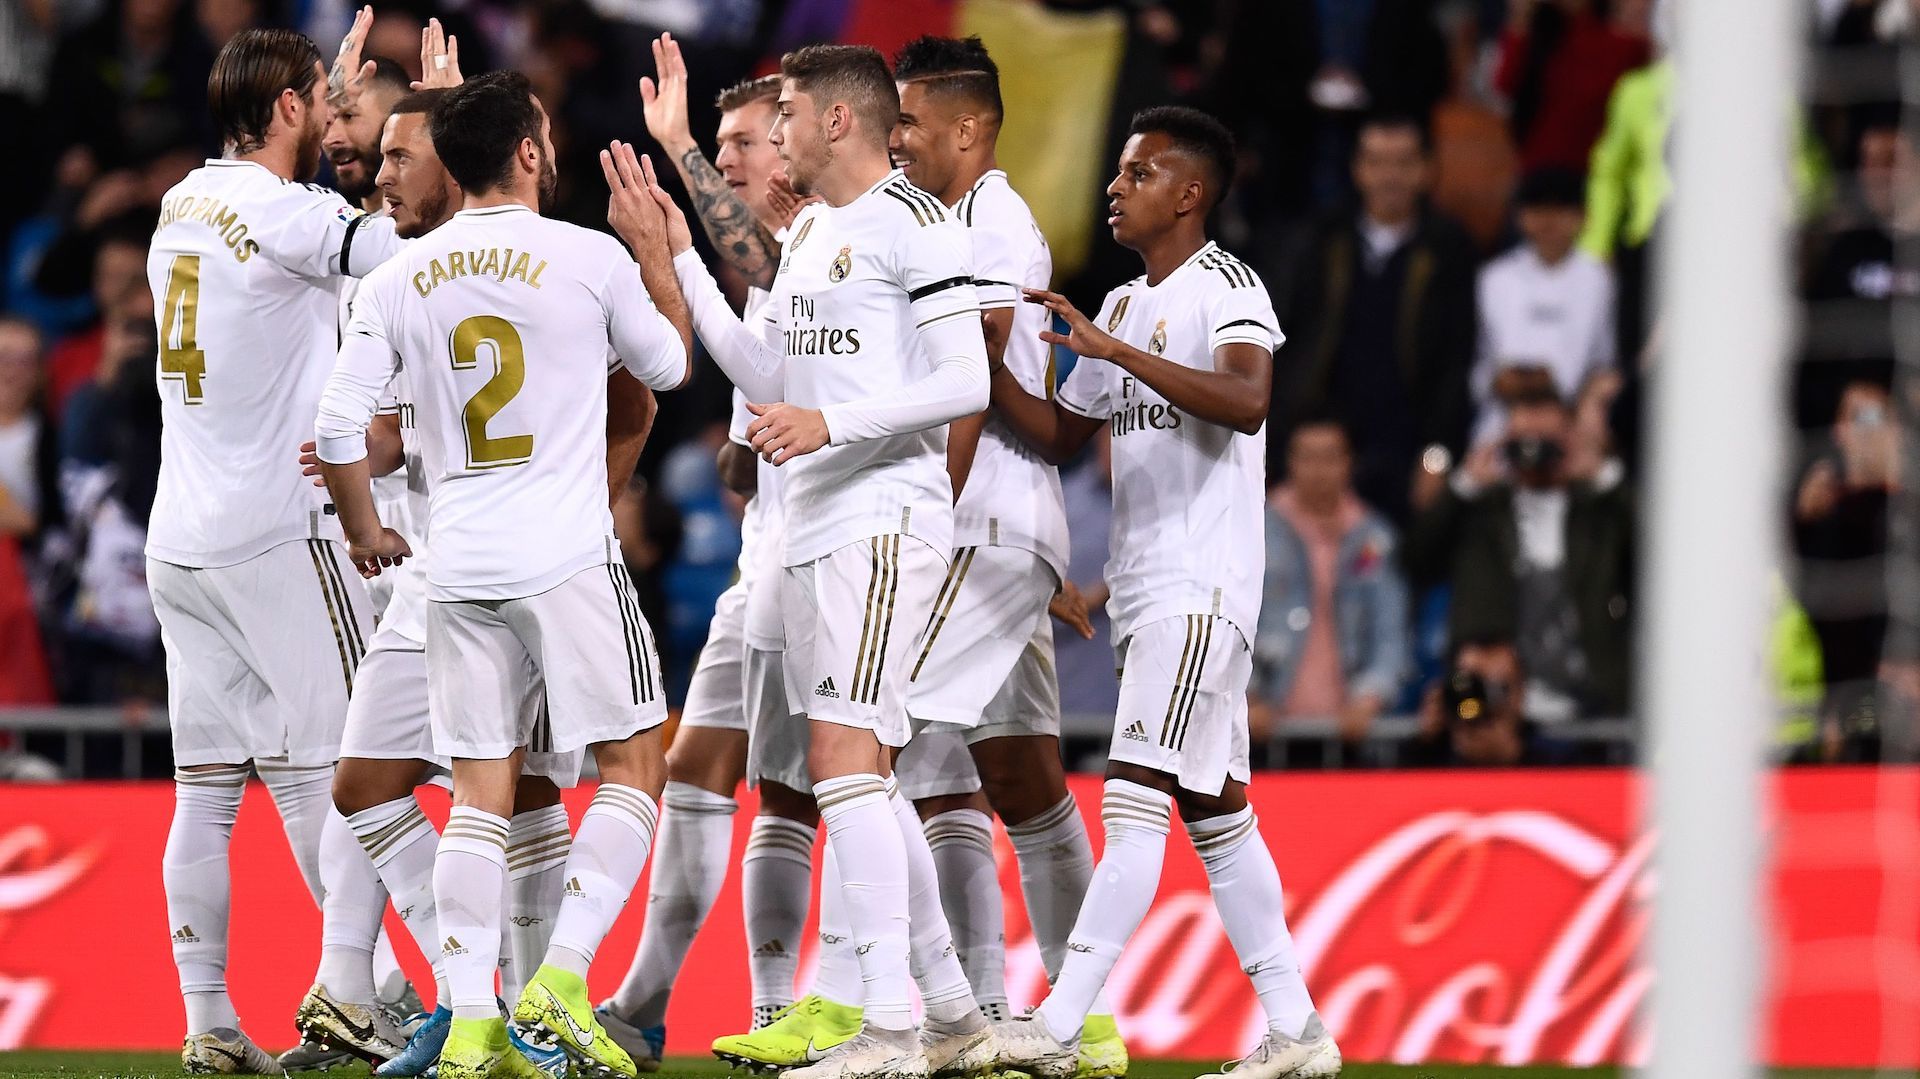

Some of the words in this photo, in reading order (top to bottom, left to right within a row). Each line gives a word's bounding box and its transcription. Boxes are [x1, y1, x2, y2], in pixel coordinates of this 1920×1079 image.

[157, 196, 195, 234] GIO
[191, 197, 260, 263] RAMOS
[412, 248, 548, 298] CARVAJAL
[792, 295, 814, 322] Fly
[160, 254, 206, 405] 4
[783, 321, 861, 356] irates
[448, 314, 534, 470] 2
[1122, 376, 1136, 399] Fl
[814, 688, 840, 699] adidas
[1121, 731, 1149, 743] adidas
